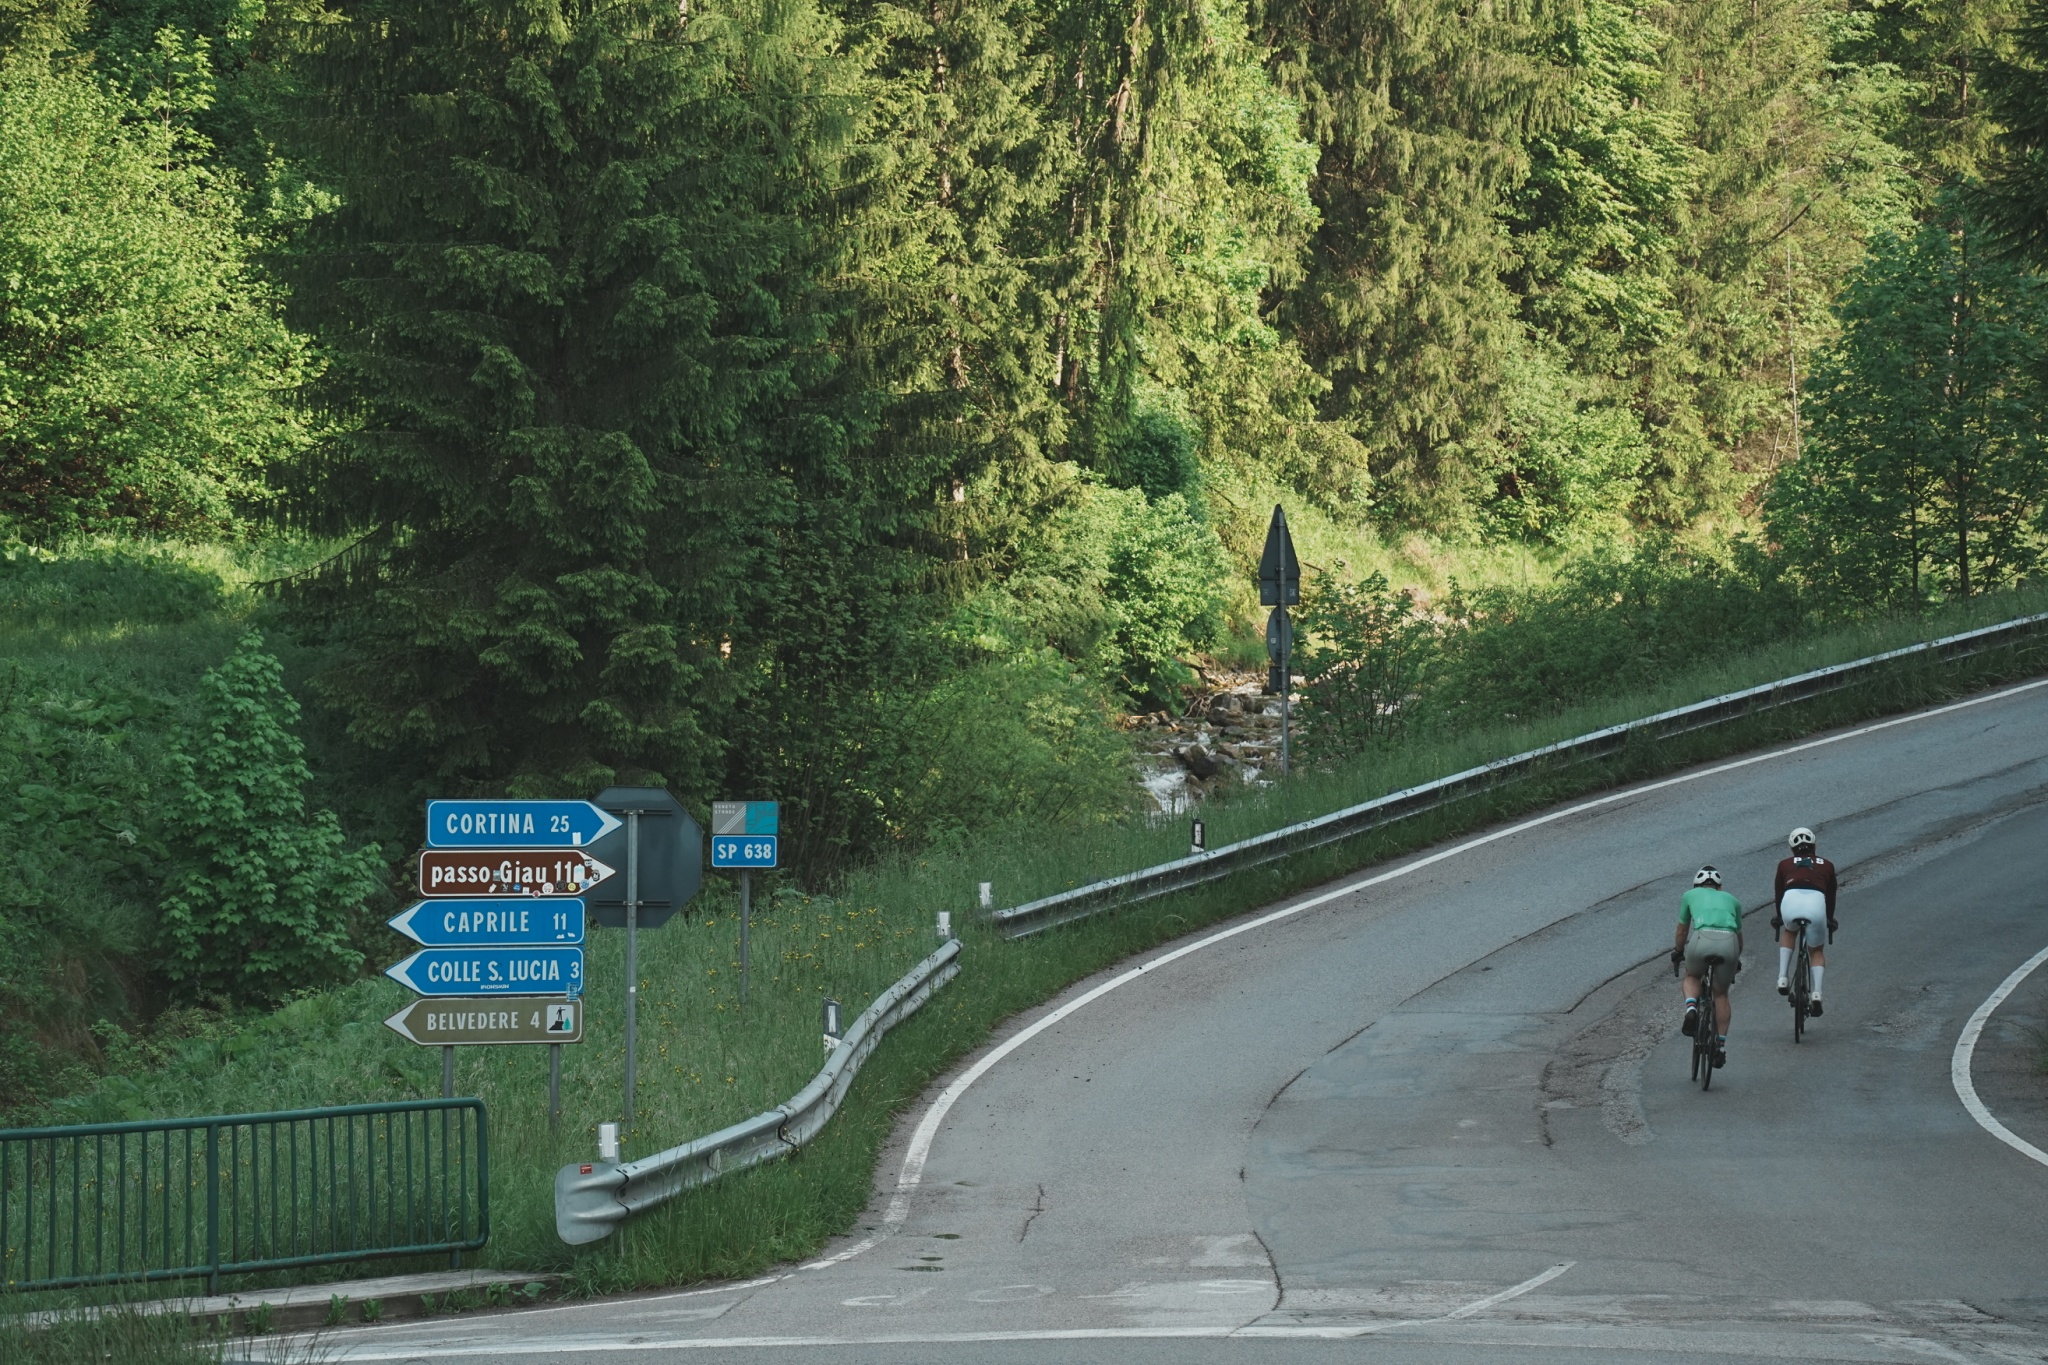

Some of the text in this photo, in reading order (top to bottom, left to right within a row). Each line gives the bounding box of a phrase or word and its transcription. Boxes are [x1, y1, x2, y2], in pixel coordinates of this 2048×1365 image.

[446, 813, 570, 834] CORTINA 25
[717, 843, 772, 859] SP 638
[431, 866, 490, 887] passo
[500, 860, 547, 883] Giau
[554, 861, 572, 883] 11
[443, 911, 567, 933] CAPRILE 11
[428, 960, 580, 982] COLLE S. LUCIA 3
[427, 1011, 540, 1031] BELVEDERE 4
[842, 1279, 1275, 1306] STOP
